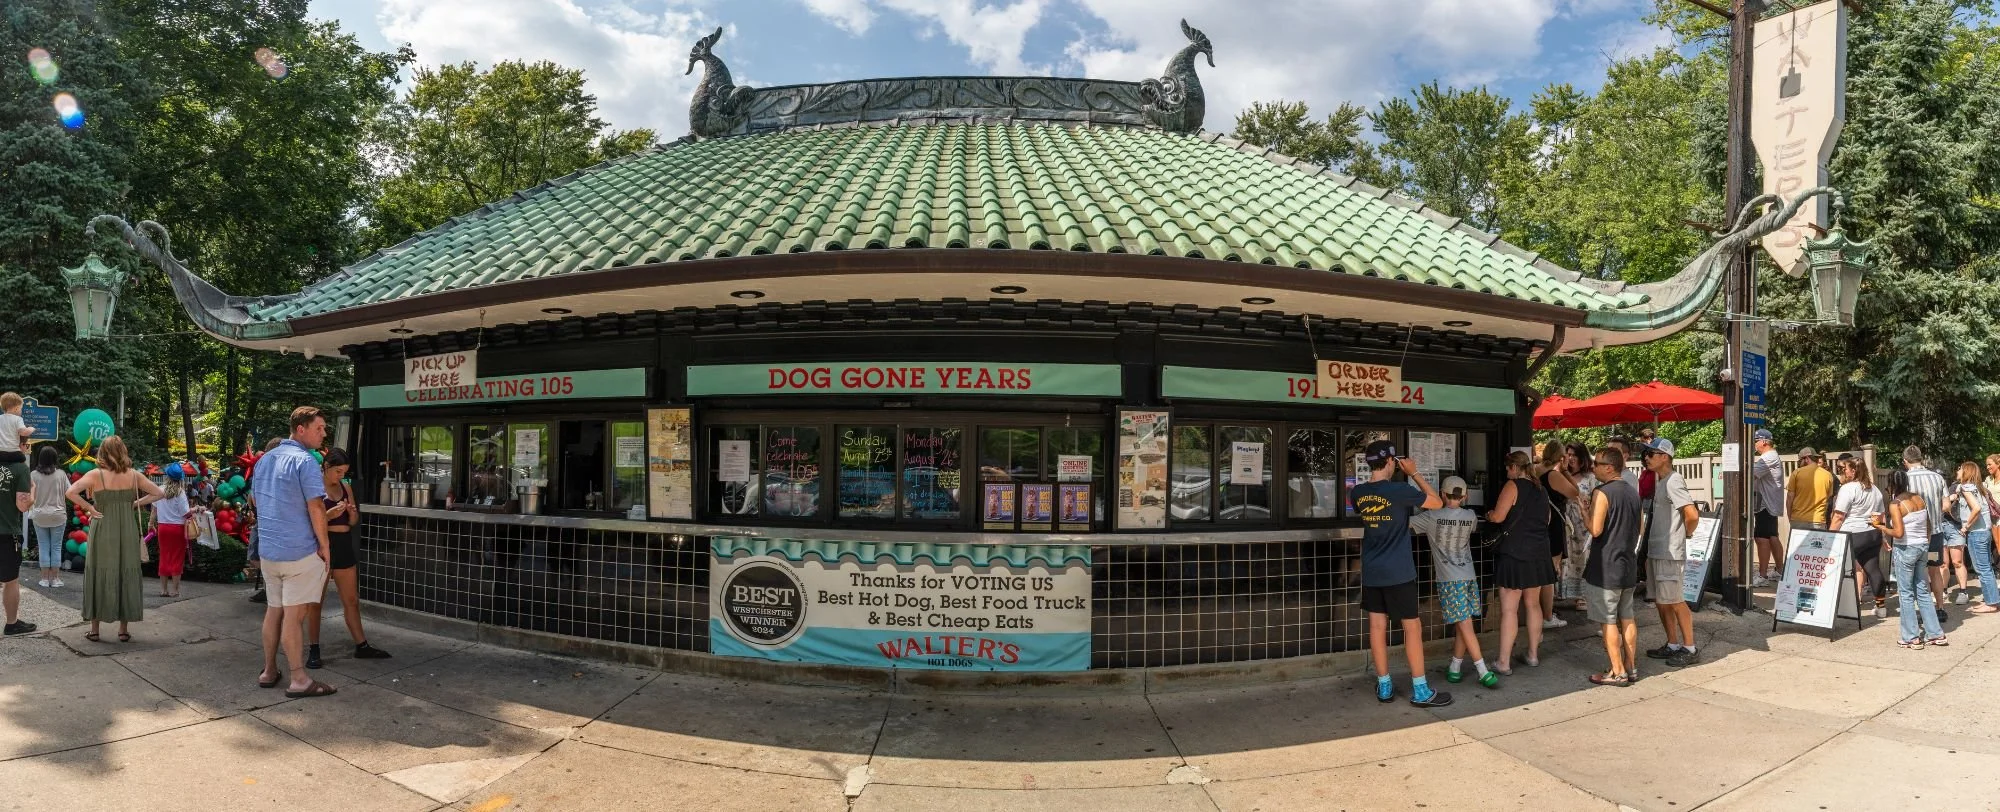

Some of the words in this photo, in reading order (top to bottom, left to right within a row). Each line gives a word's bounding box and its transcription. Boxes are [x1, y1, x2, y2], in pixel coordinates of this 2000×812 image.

[411, 357, 442, 374] PICK
[444, 354, 467, 370] UP
[1328, 361, 1392, 383] ORDER
[418, 372, 461, 388] HERE
[768, 368, 831, 389] DOG
[841, 367, 925, 389] GONE
[935, 368, 1032, 390] YEARS
[406, 378, 534, 403] CELEBRATING
[540, 376, 574, 396] 105
[1336, 380, 1386, 399] HERE
[769, 429, 798, 448] Come
[843, 430, 887, 450] Sunday
[906, 433, 943, 454] Monday
[843, 449, 872, 466] August
[904, 451, 938, 467] August
[1436, 518, 1457, 527] GOING
[1793, 553, 1811, 563] OUR
[1812, 555, 1835, 565] FOOD
[1800, 562, 1826, 572] TRUCK
[849, 573, 916, 590] Thanks
[921, 573, 946, 590] for
[951, 575, 1027, 592] VOTING
[1031, 577, 1053, 591] US
[1796, 570, 1805, 578] IS
[1805, 571, 1827, 580] ALSO
[1798, 577, 1823, 588] OPEN!
[732, 585, 795, 607] BEST
[817, 590, 854, 606] Best
[858, 592, 890, 607] Hot
[895, 594, 936, 612] Dog,
[940, 594, 977, 610] Best
[982, 595, 1029, 610] Food
[1033, 595, 1087, 610] Truck
[732, 606, 793, 617] WESTCHESTER
[740, 615, 787, 627] WINNER
[752, 626, 775, 635] 2024
[867, 612, 881, 626] &
[885, 612, 922, 627] Best
[927, 613, 990, 631] Cheap
[995, 613, 1034, 629] Eats
[876, 635, 1022, 664] WALTER'S
[927, 658, 947, 667] HOT
[948, 659, 973, 668] DOGS
